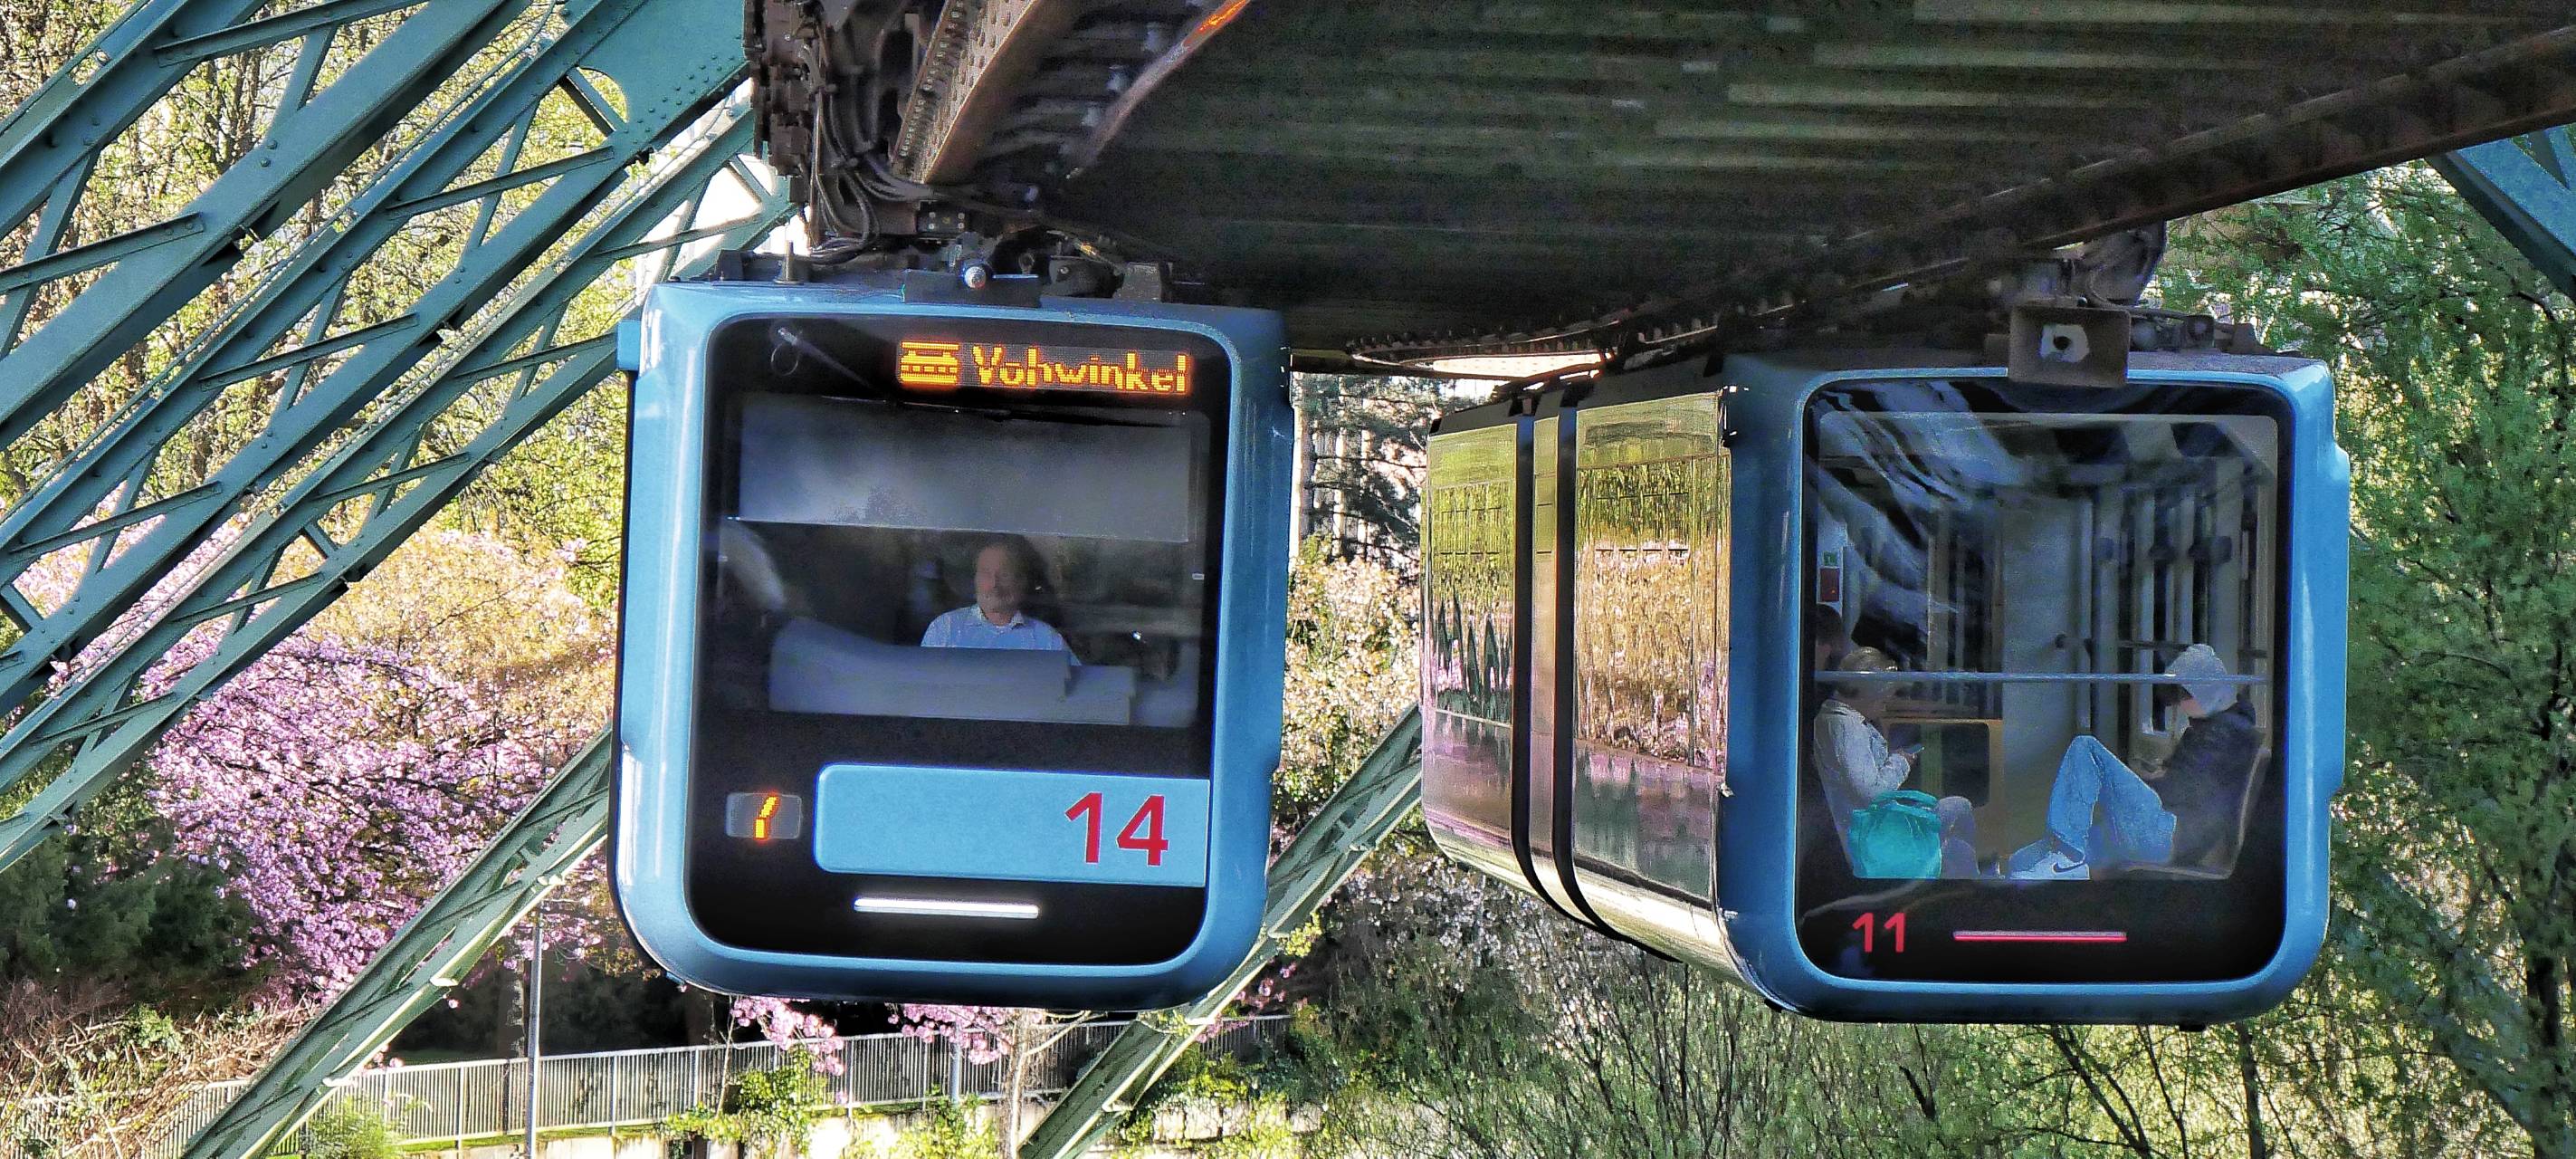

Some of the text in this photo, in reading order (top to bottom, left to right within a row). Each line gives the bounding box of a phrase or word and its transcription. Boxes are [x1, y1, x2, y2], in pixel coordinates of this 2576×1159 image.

[971, 345, 1187, 392] Vohwinkel
[1064, 791, 1169, 867] 14
[1852, 913, 1906, 953] 11
